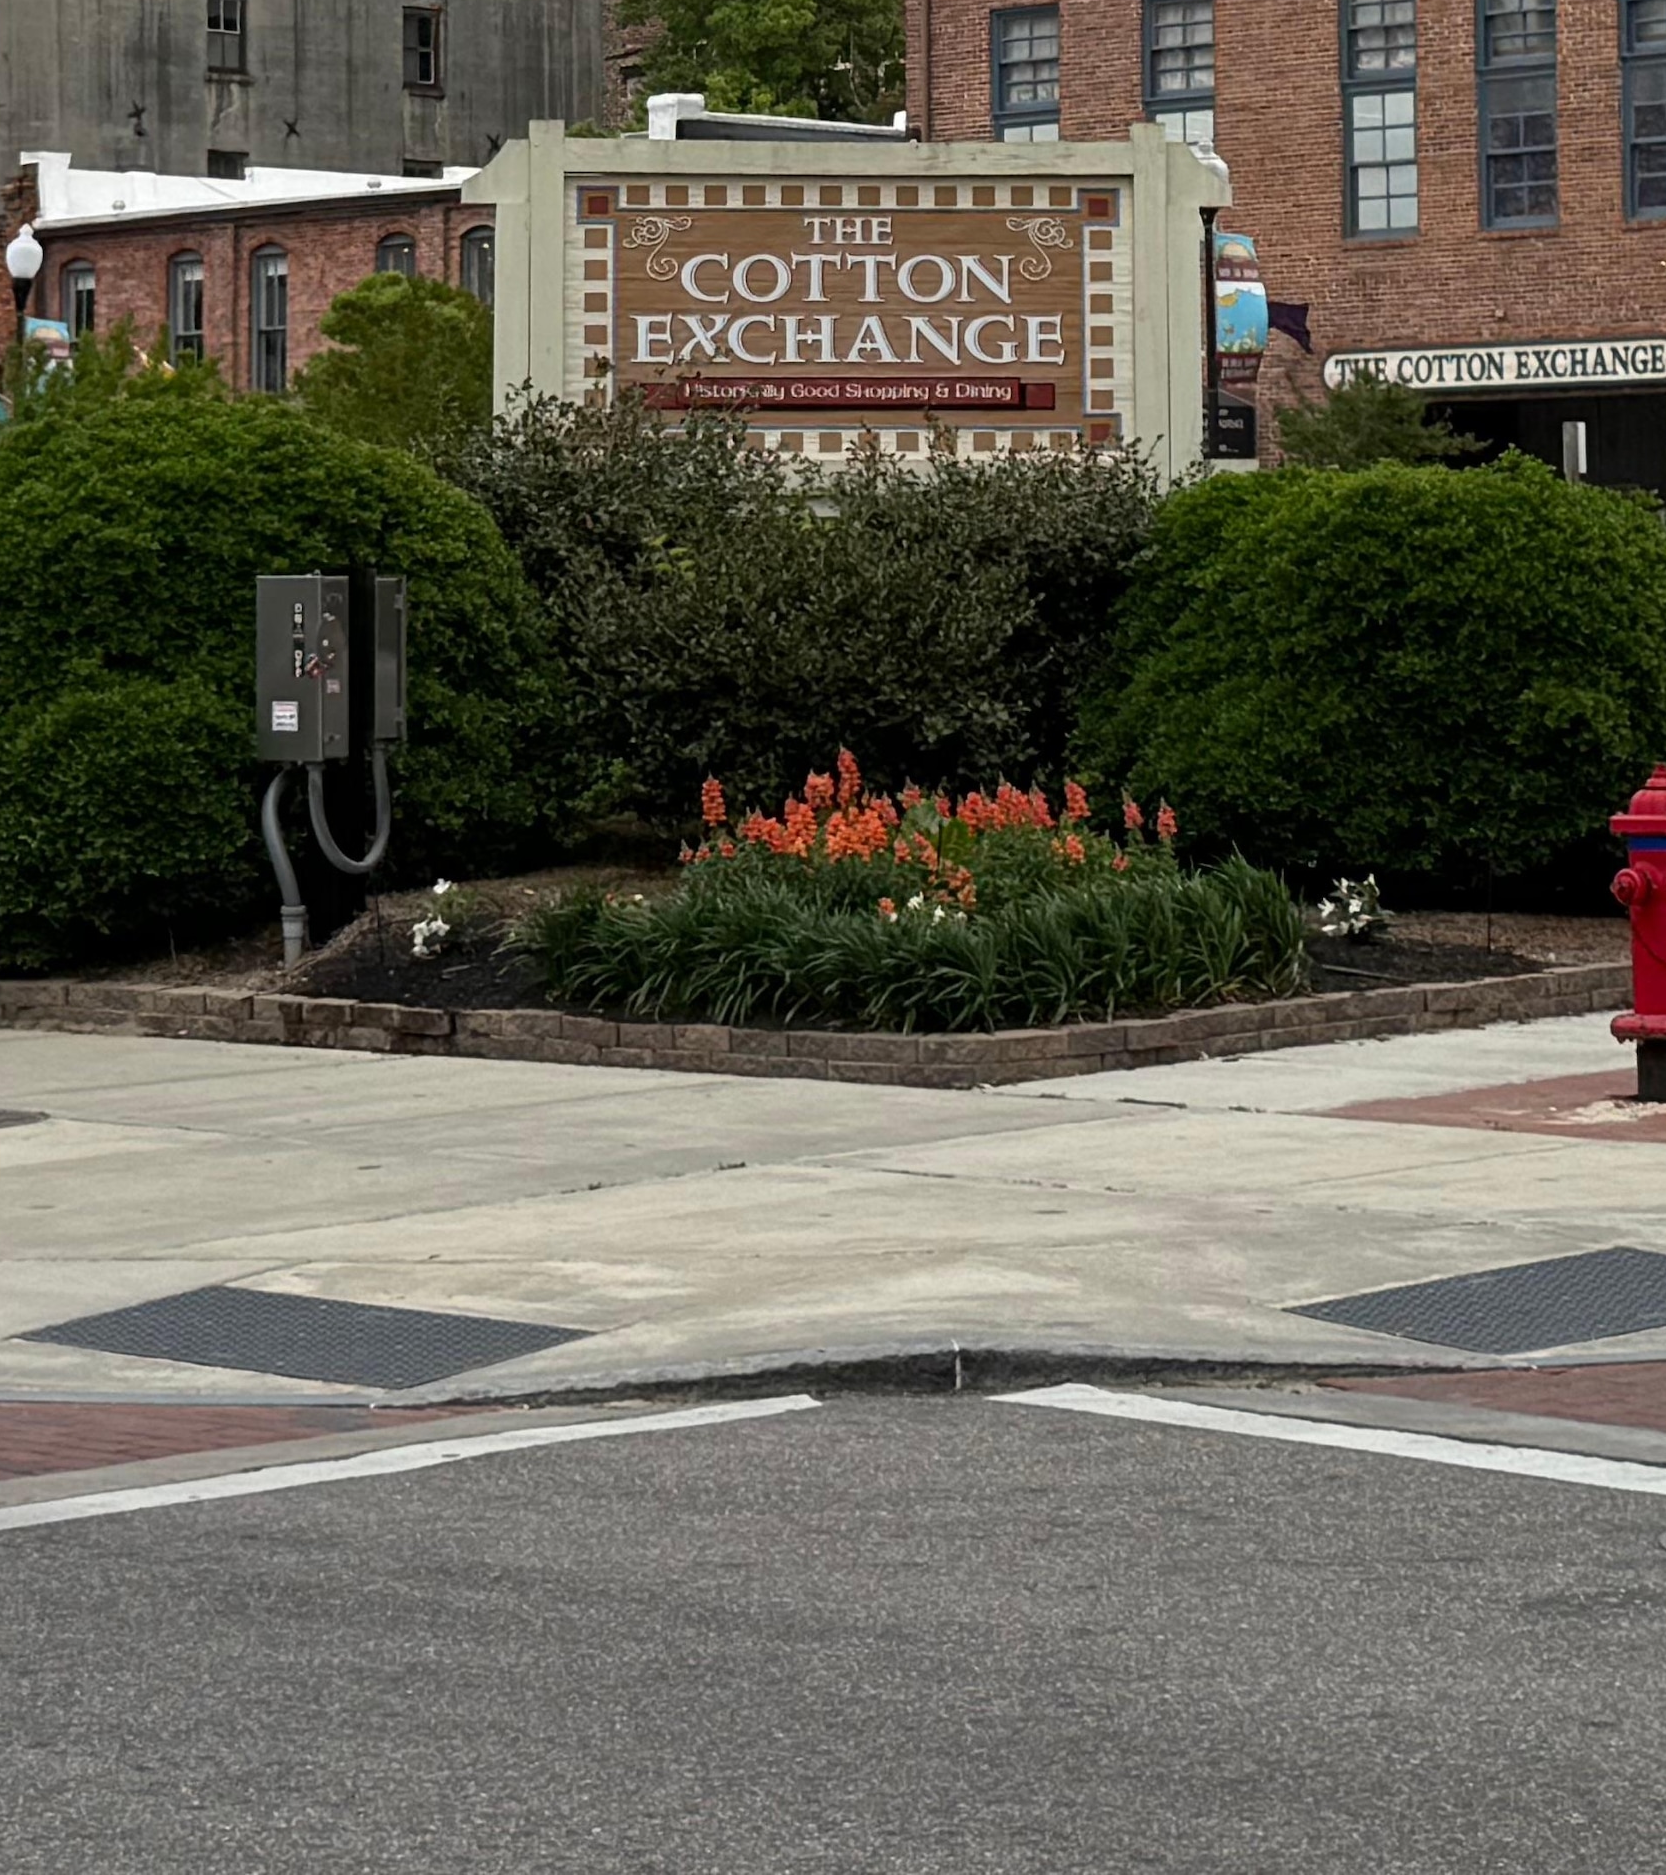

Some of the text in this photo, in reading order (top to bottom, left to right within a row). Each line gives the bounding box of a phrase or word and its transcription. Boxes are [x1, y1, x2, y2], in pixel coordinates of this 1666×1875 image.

[804, 216, 894, 245] THE
[679, 250, 1016, 304] COTTON
[629, 311, 1066, 366] EXCHANGE
[1335, 344, 1666, 384] THE COTTON EXCHANGE
[790, 382, 840, 398] Good
[844, 382, 930, 401] Shopping
[934, 383, 949, 399] &
[955, 382, 1013, 400] Dining
